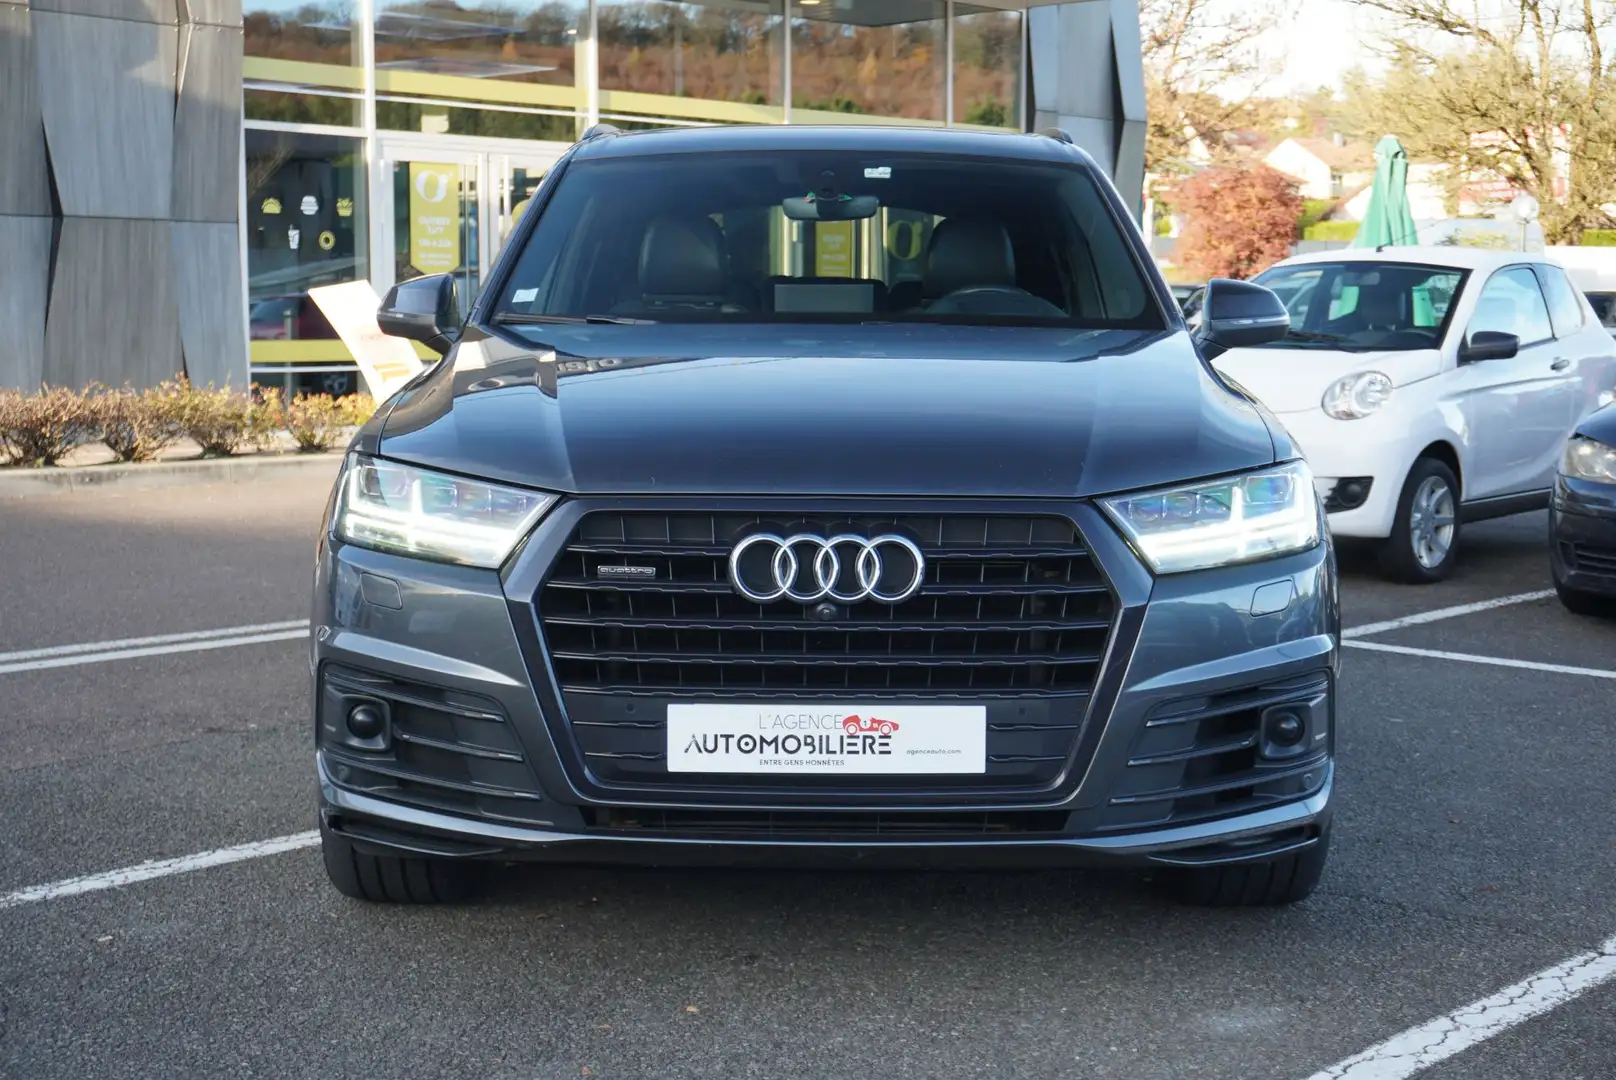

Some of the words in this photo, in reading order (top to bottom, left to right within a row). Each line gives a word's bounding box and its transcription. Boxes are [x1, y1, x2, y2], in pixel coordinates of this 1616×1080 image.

[599, 566, 653, 575] quattro
[758, 714, 844, 730] L'AGENCE
[906, 748, 962, 756] agenceauto.com
[805, 758, 845, 766] HONNÊTES
